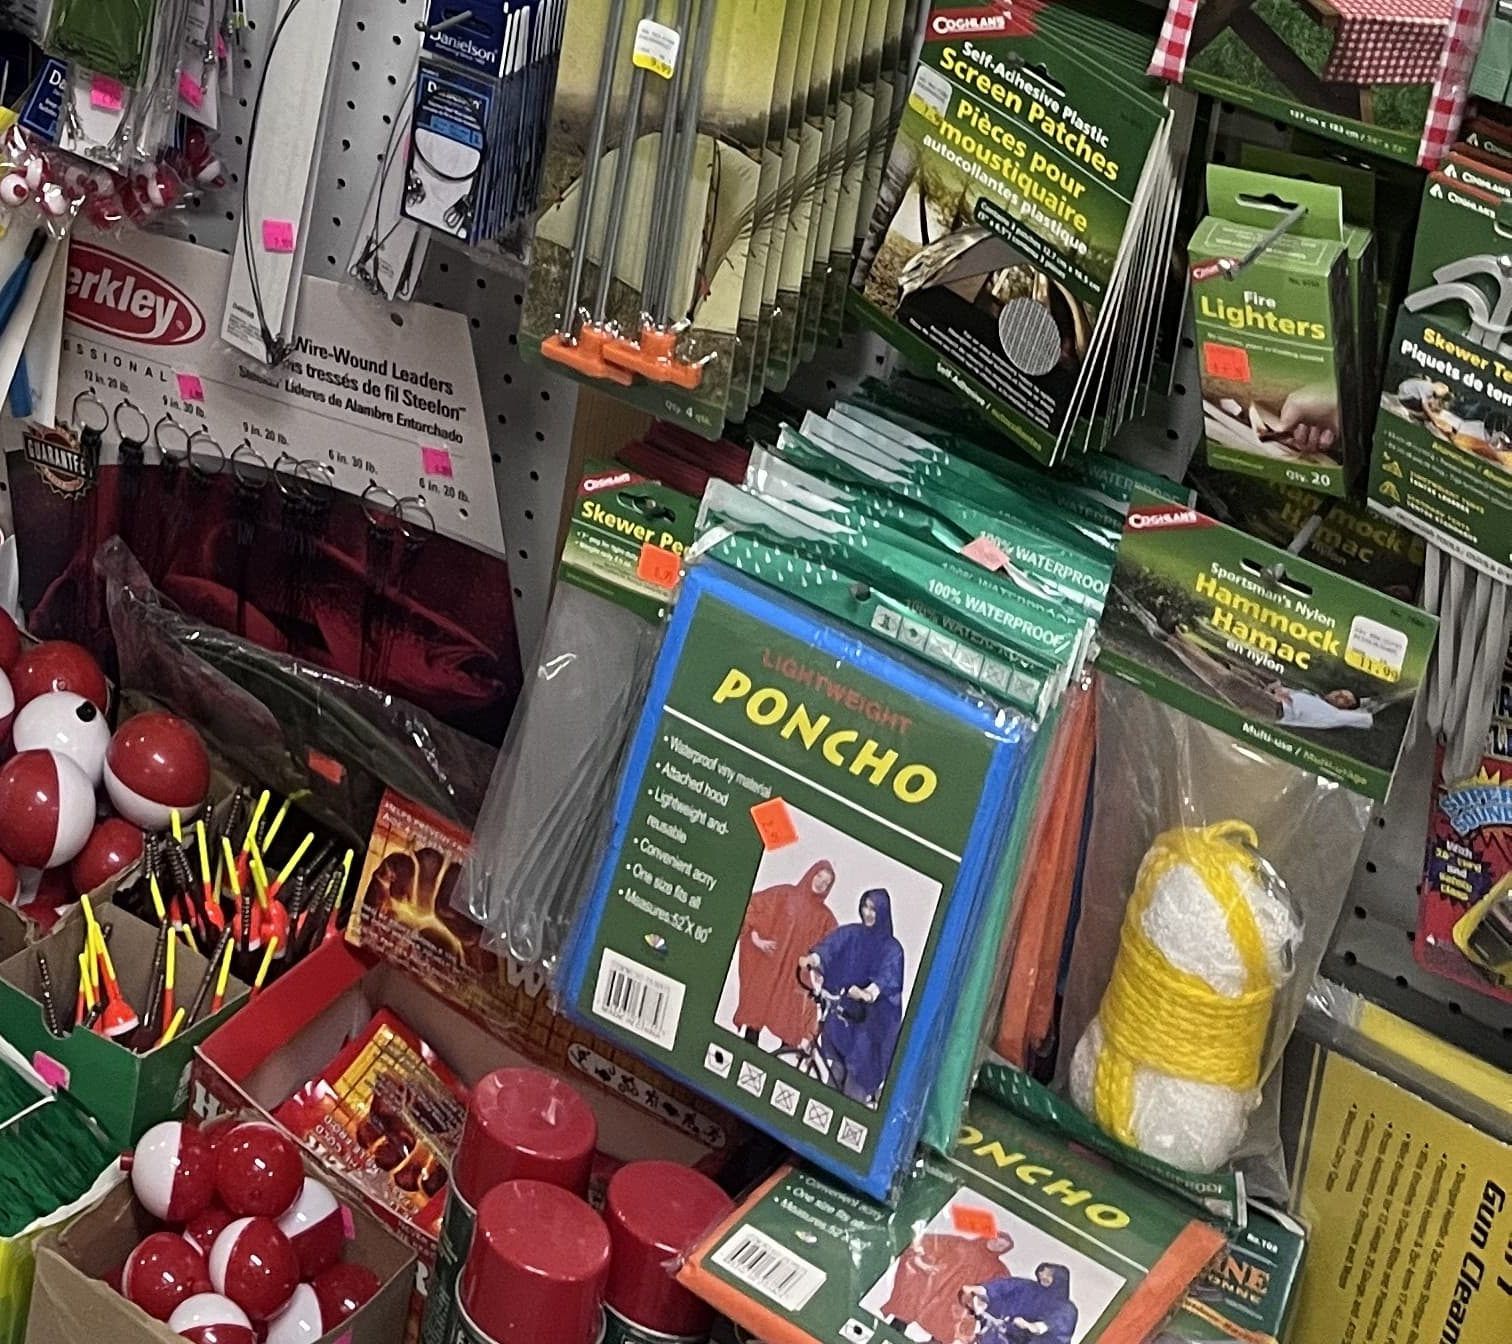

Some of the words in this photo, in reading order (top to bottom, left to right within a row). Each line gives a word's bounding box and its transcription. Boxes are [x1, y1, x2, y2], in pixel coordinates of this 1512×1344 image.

[938, 47, 1022, 116] Screen
[1027, 99, 1120, 182] Patches
[961, 40, 1061, 110] Self-Adhesive
[1060, 104, 1110, 149] Plastic
[938, 120, 1088, 232] moustiquaire
[957, 99, 1028, 158] Pièces
[1030, 152, 1086, 200] pour
[1199, 294, 1326, 342] Lighters
[1243, 288, 1277, 311] Fire
[328, 449, 334, 460] 6
[350, 455, 362, 470] 30
[363, 459, 378, 474] lb.
[419, 477, 425, 489] 6
[442, 485, 454, 498] 20
[456, 489, 470, 503] lb.
[1195, 571, 1341, 657] Hammock
[1210, 562, 1291, 608] Sportsman's
[1294, 600, 1336, 628] Nylon
[1210, 607, 1312, 671] Hamac
[1226, 640, 1244, 653] en
[1245, 644, 1286, 675] nylon
[761, 648, 912, 734] LIGHTWEIGHT
[712, 668, 938, 803] PONCHO
[1242, 722, 1293, 752] Multi-use
[661, 761, 703, 795] Attached
[704, 784, 729, 807] hood
[646, 814, 687, 844] reusable
